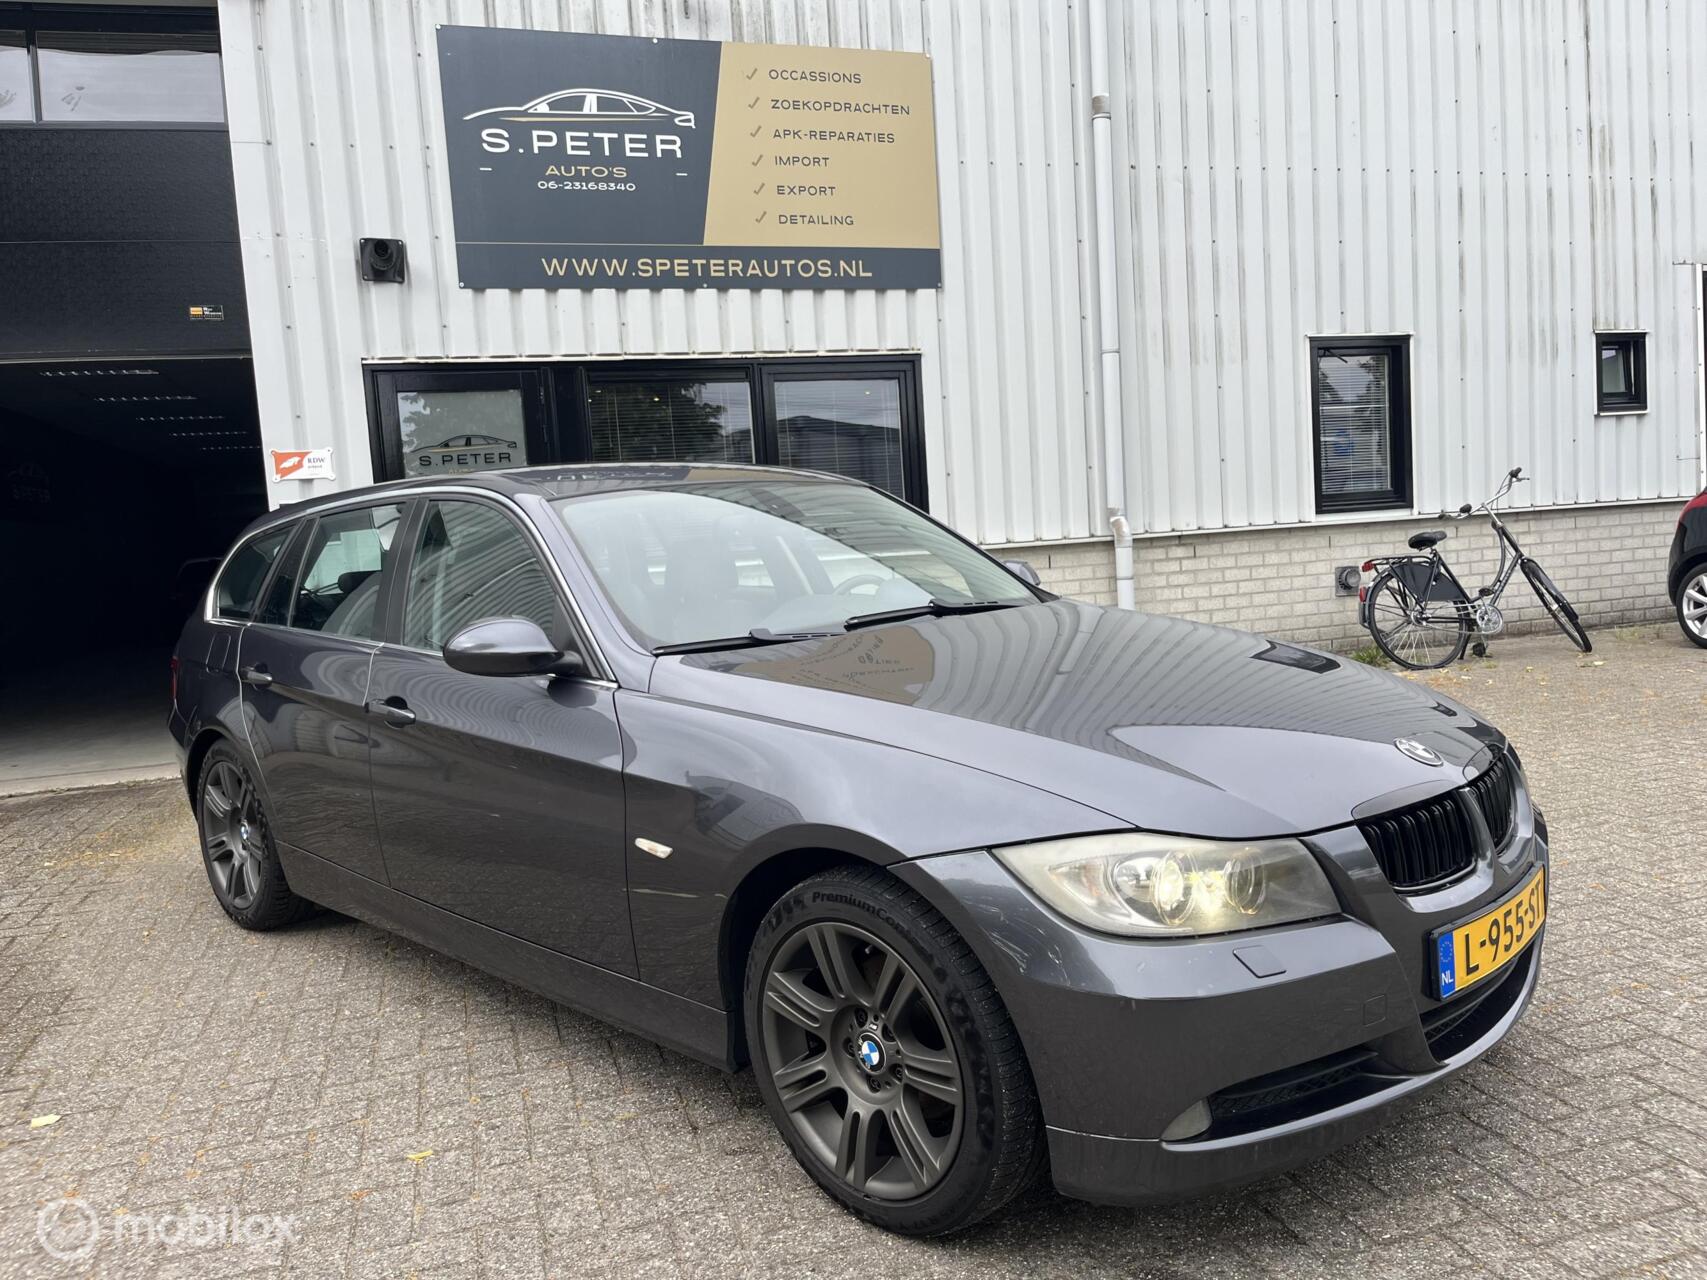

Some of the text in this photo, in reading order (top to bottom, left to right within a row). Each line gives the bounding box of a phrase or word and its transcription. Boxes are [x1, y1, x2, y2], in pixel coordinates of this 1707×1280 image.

[768, 69, 862, 84] OCCASSIONS
[770, 99, 910, 116] ZOEKOPDRACHTEN
[480, 128, 683, 159] S.PETER
[773, 129, 896, 144] APK-REPARATIES
[774, 155, 830, 168] IMPORT
[545, 165, 628, 179] AUTO'S
[537, 180, 637, 192] 06-23168340
[776, 185, 836, 197] EXPORT
[778, 214, 855, 226] DETAILING
[541, 258, 873, 278] WWW.SPETERAUTOS.NL
[418, 452, 512, 467] S.PETER
[1464, 878, 1541, 977] L-955-ST
[1441, 969, 1454, 987] NL
